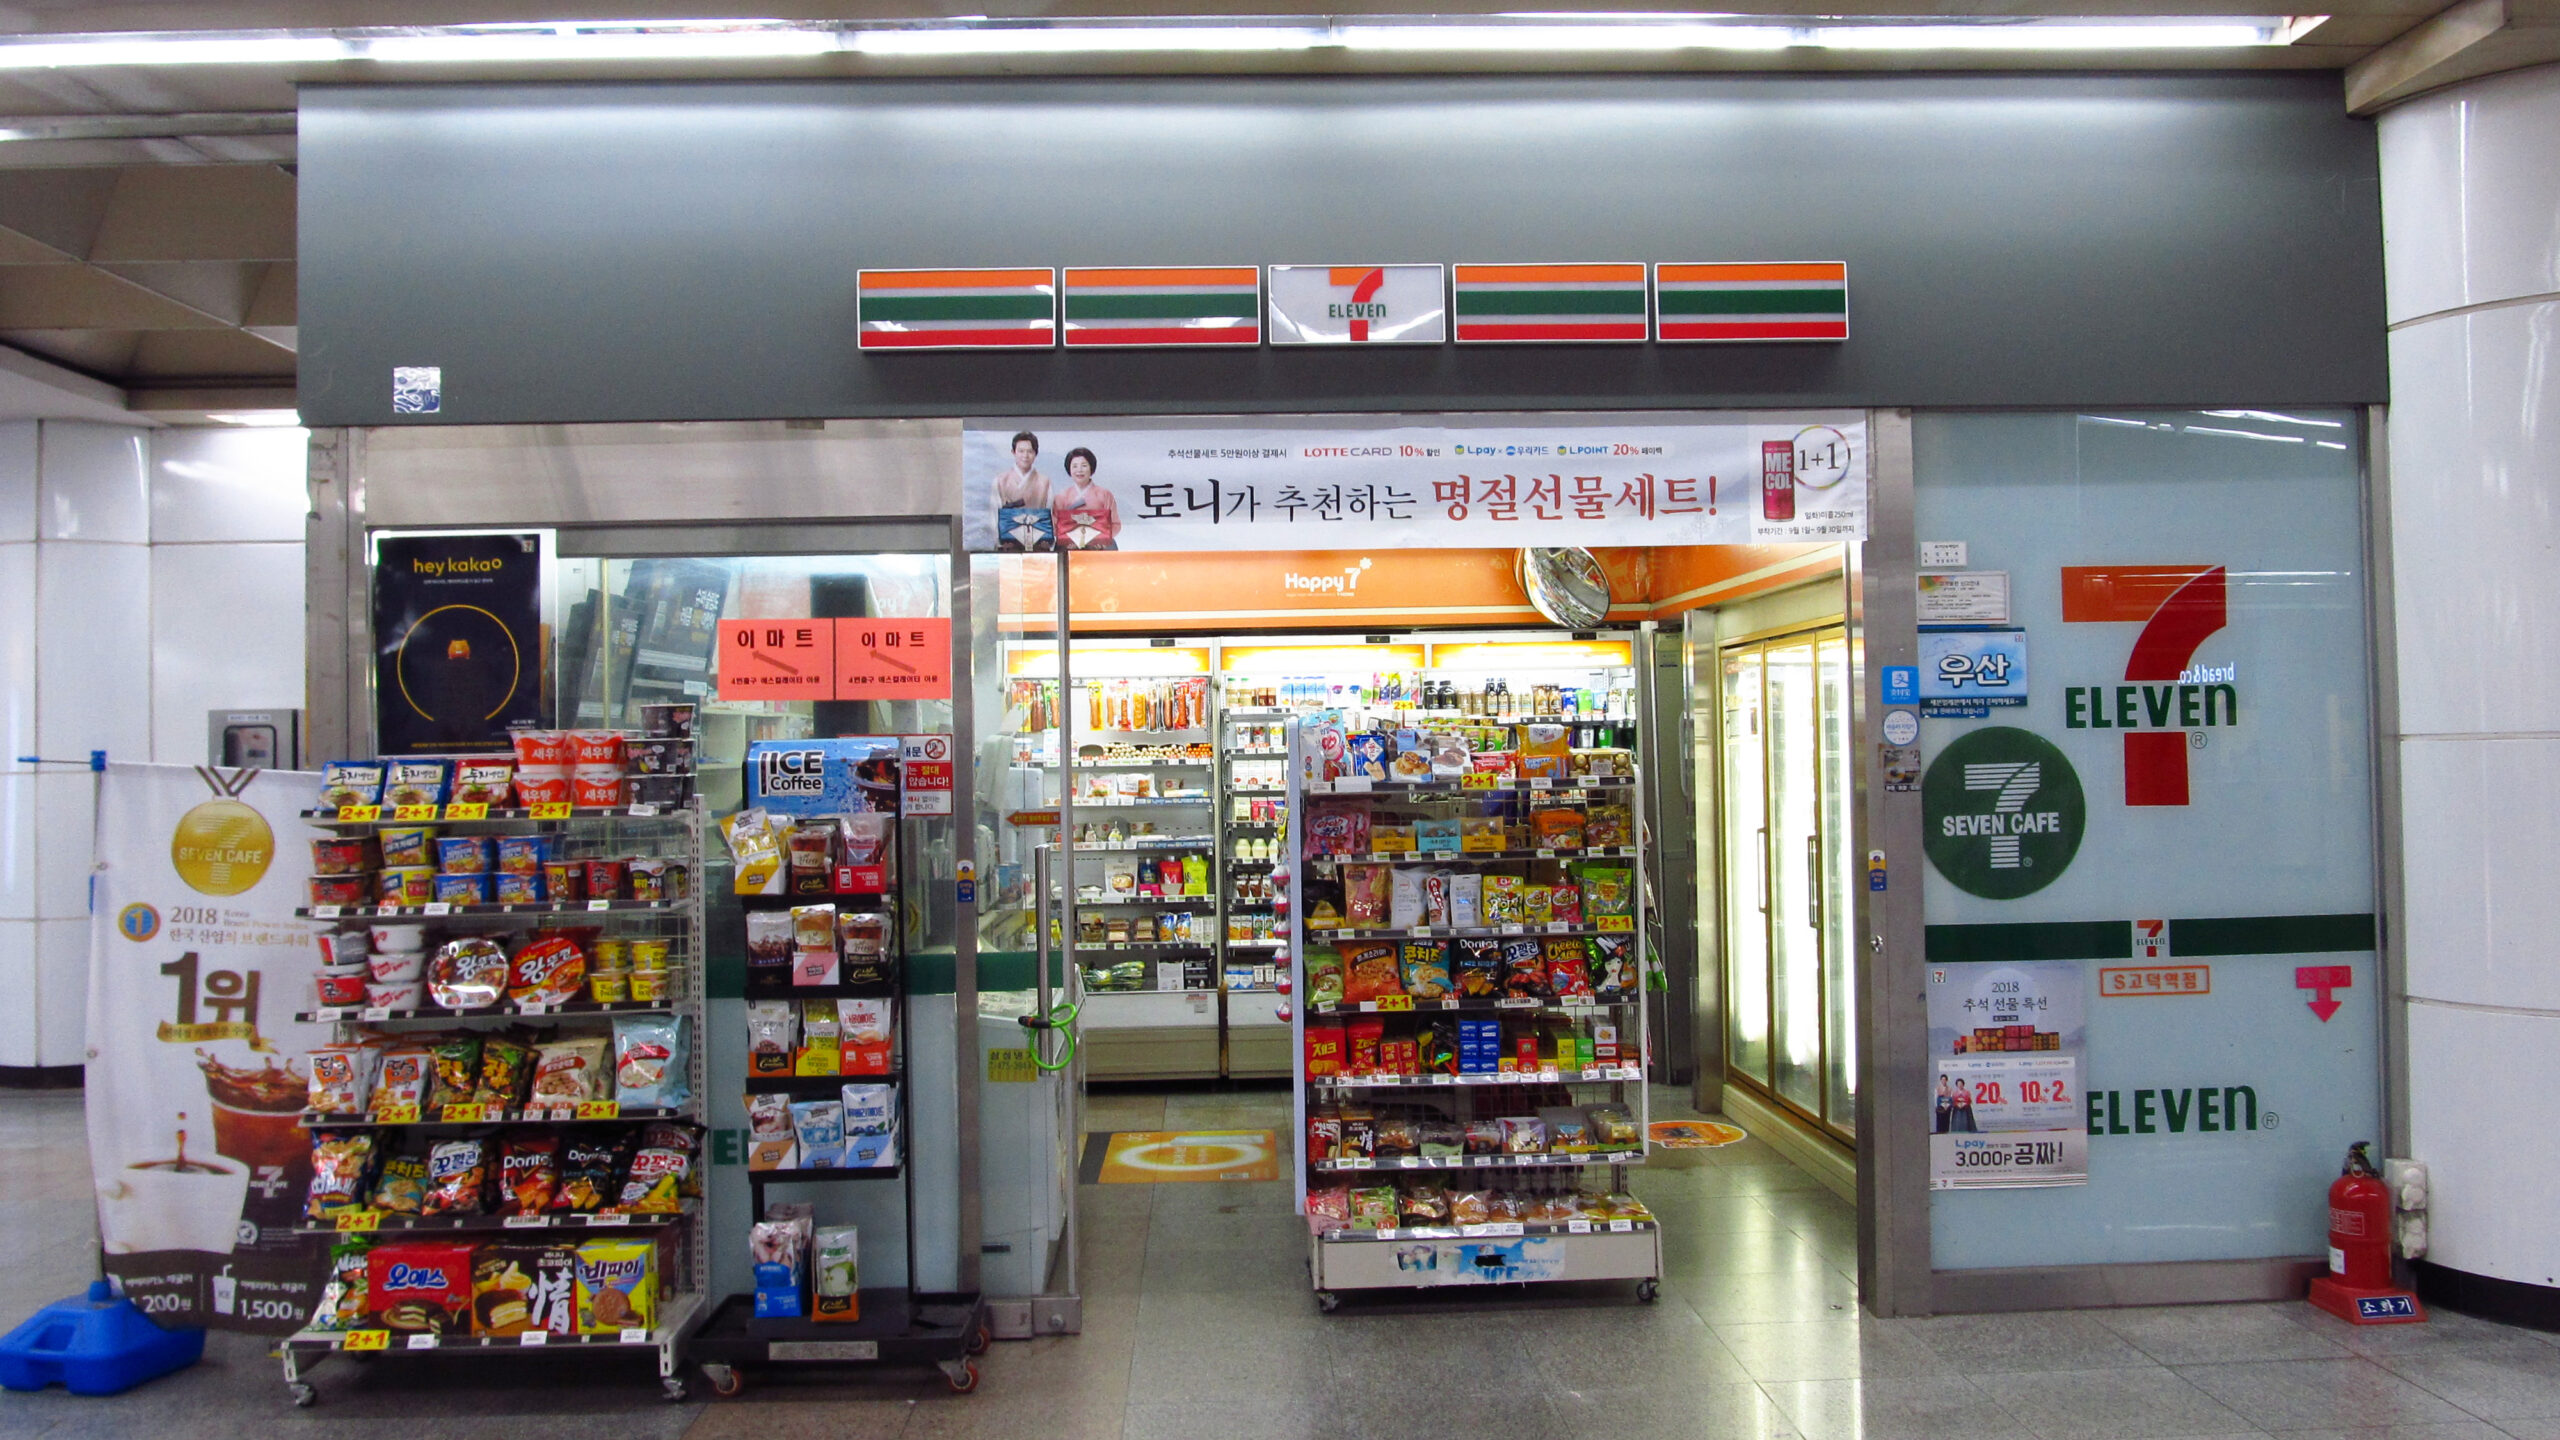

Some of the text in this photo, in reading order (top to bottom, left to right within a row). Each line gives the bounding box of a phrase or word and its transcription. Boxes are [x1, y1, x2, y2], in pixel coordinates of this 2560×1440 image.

[1167, 447, 1287, 459] 추석선물세트 5만원이상 결제시
[1304, 447, 1349, 457] LOTTE
[1350, 446, 1392, 457] CARD
[1399, 444, 1424, 457] 10%
[1613, 443, 1639, 456] 20%
[1799, 441, 1840, 471] 1+1
[1765, 452, 1793, 472] ME
[1765, 473, 1792, 490] COL
[1137, 473, 1717, 525] 토니가 추천하는 명절선물세트!
[413, 556, 502, 577] hey kakao
[1284, 572, 1344, 593] Happy
[1939, 653, 2011, 688] 우산
[1393, 701, 1414, 710] 2+1
[580, 746, 613, 760] 새우탕
[769, 775, 823, 791] Coffee
[1462, 775, 1495, 788] 2+1
[584, 788, 617, 802] 새우탕
[339, 806, 378, 820] 2+1
[395, 805, 434, 819] 2+1
[445, 804, 484, 818] 2+1
[530, 804, 569, 817] 2+1
[1942, 812, 2060, 836] SEVEN CAFE
[179, 848, 262, 865] SEVEN CAFE
[170, 906, 218, 925] 2018
[1598, 917, 1631, 930] 2+1
[169, 928, 194, 942] 한국
[200, 929, 237, 945] 산업의
[1460, 939, 1499, 949] Doritos
[1506, 941, 1540, 963] 꼬깔콘
[518, 946, 572, 985] 왕뚜껑
[160, 951, 262, 1027] 1위
[1991, 982, 2020, 993] 2018
[2114, 972, 2197, 990] S고덕역점
[1377, 996, 1410, 1009] 2+1
[1963, 996, 2048, 1012] 추석 선물 특선
[378, 1106, 417, 1122] 2+1
[442, 1105, 481, 1121] 2+1
[578, 1103, 617, 1118] 2+1
[2014, 1141, 2063, 1165] 공짜!
[433, 1151, 479, 1174] 꼬깔콘
[631, 1154, 684, 1173] 꼬깔콘
[338, 1214, 377, 1229] 2+1
[383, 1264, 448, 1291] 오예스
[528, 1266, 573, 1335] 情
[2363, 1297, 2412, 1314] 소화기
[346, 1332, 386, 1347] 2+1
